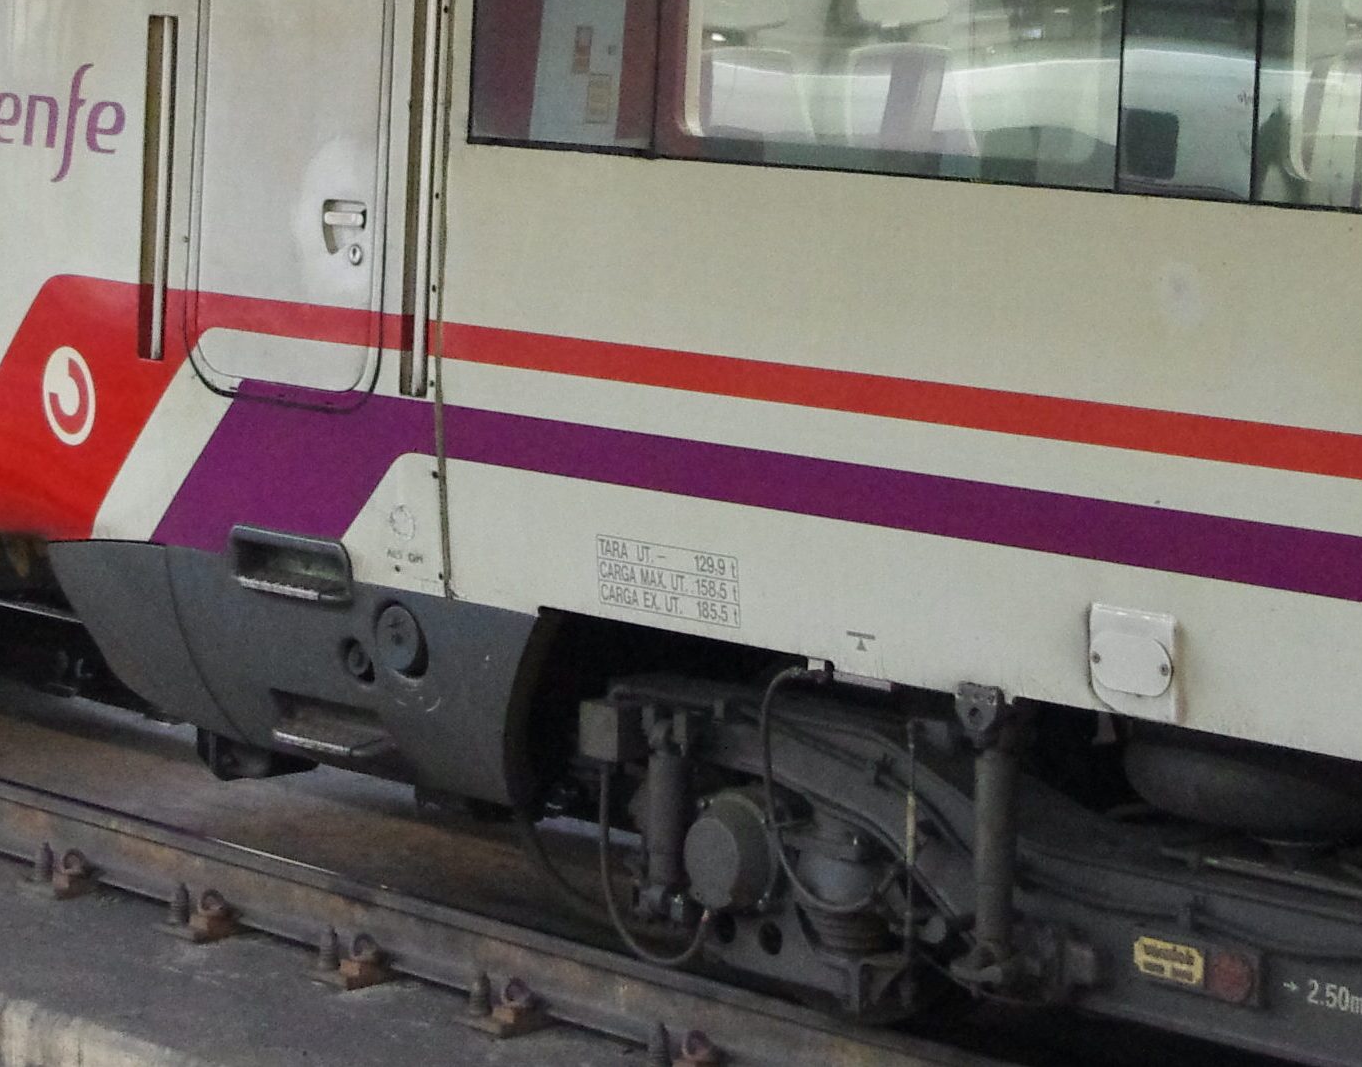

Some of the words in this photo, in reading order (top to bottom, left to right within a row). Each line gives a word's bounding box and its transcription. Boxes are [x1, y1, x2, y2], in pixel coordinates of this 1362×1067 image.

[599, 538, 628, 559] TARA
[637, 545, 654, 563] UT.
[694, 554, 725, 575] 129.9
[599, 561, 636, 583] CARGA
[696, 579, 727, 599] 158.5
[601, 584, 639, 606] CARGA
[697, 601, 728, 621] 185.5
